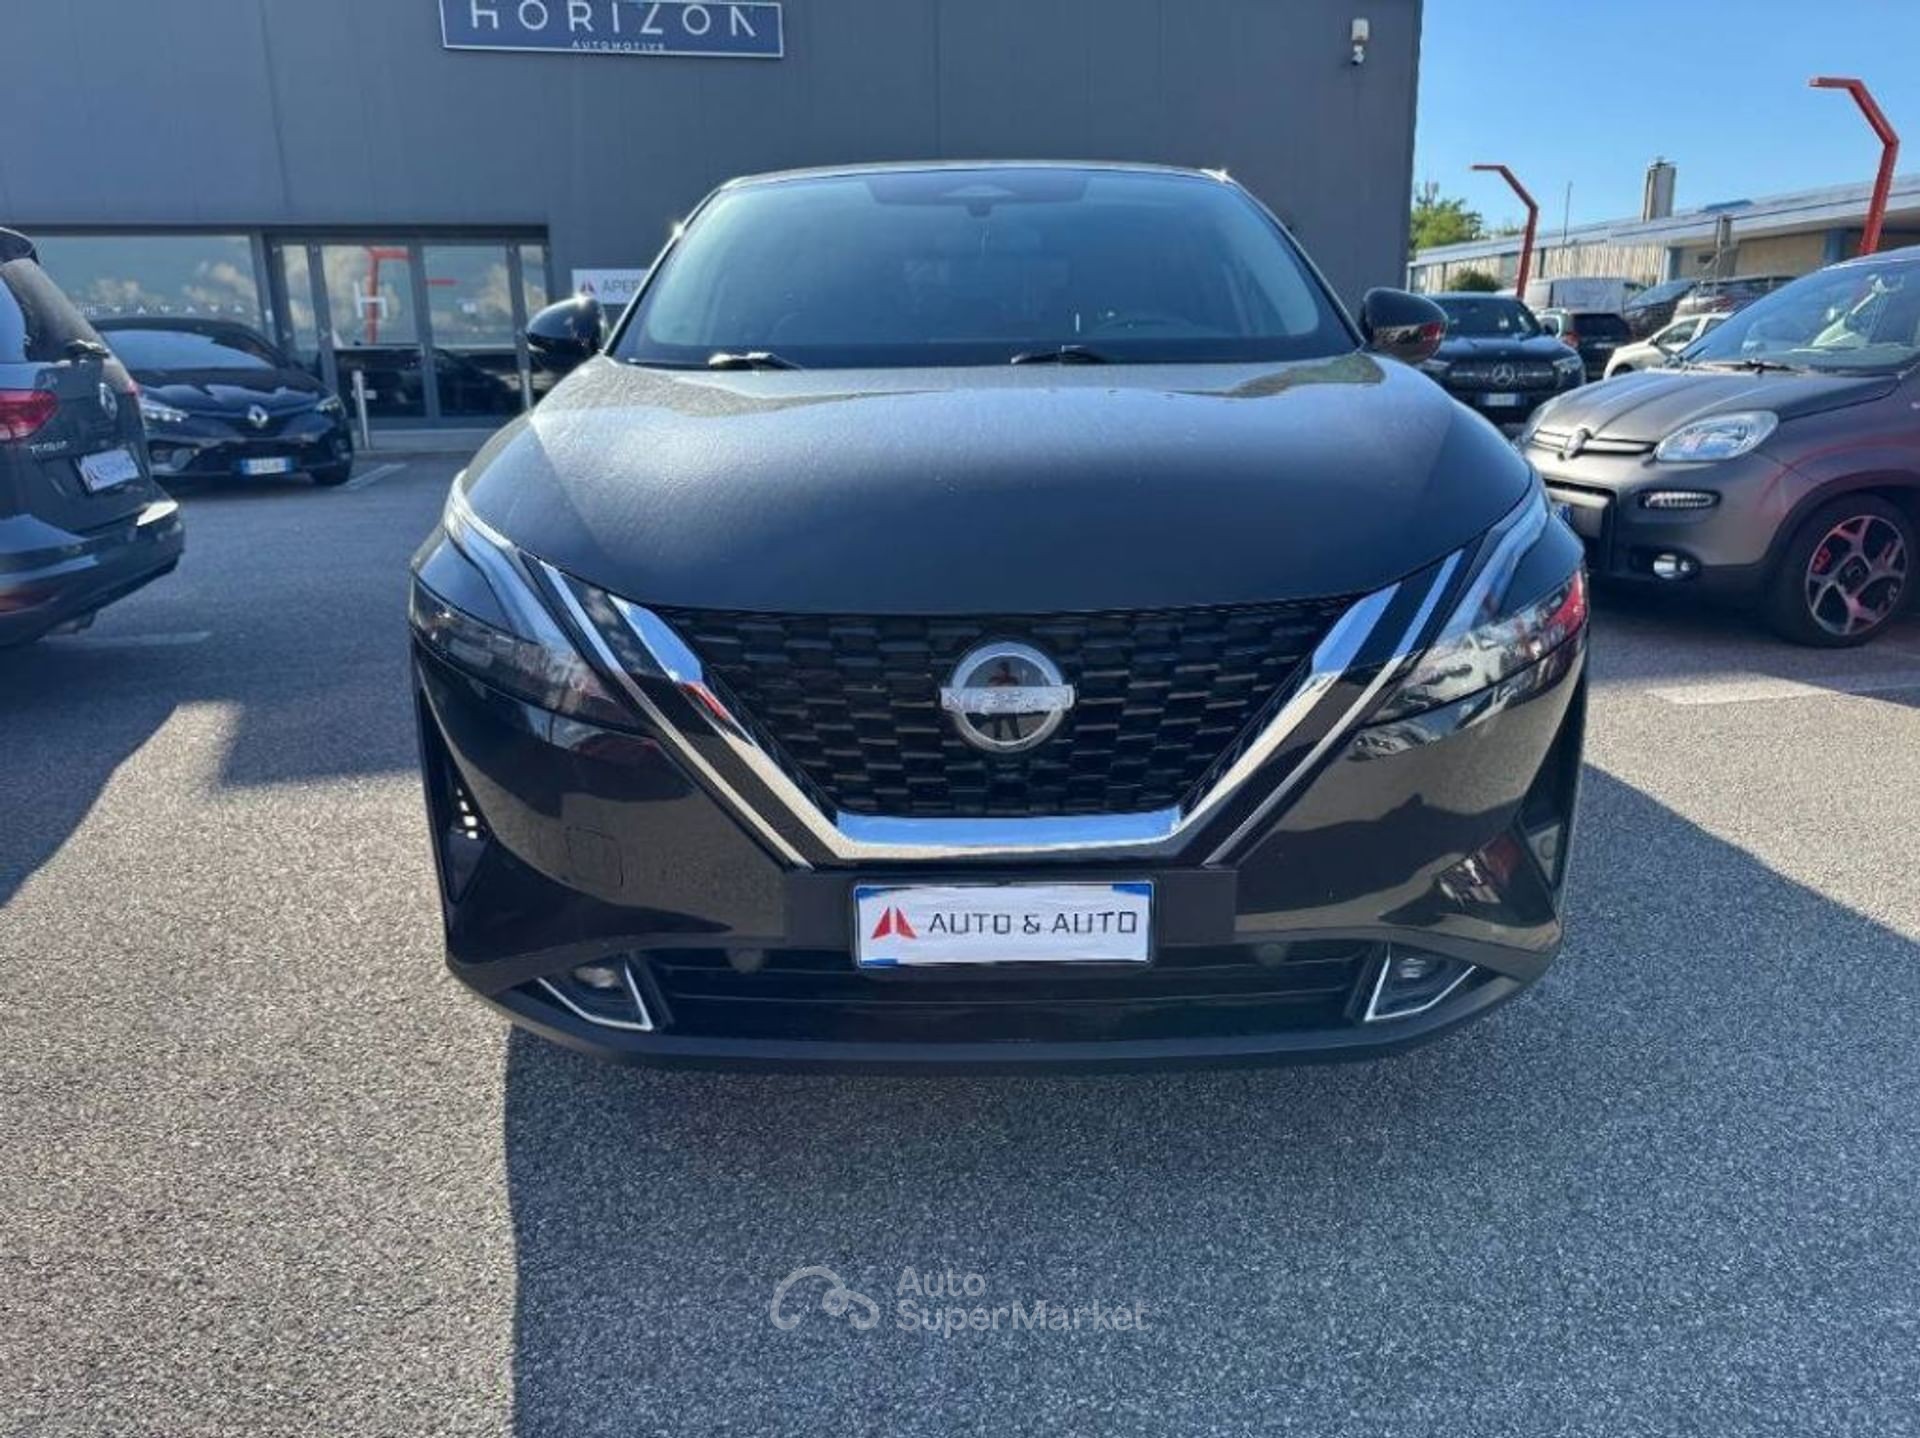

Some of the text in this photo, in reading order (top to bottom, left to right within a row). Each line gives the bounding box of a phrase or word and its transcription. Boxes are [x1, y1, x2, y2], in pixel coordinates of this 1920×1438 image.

[470, 0, 756, 37] HORIZON
[928, 911, 1138, 934] AUTO & AUTO
